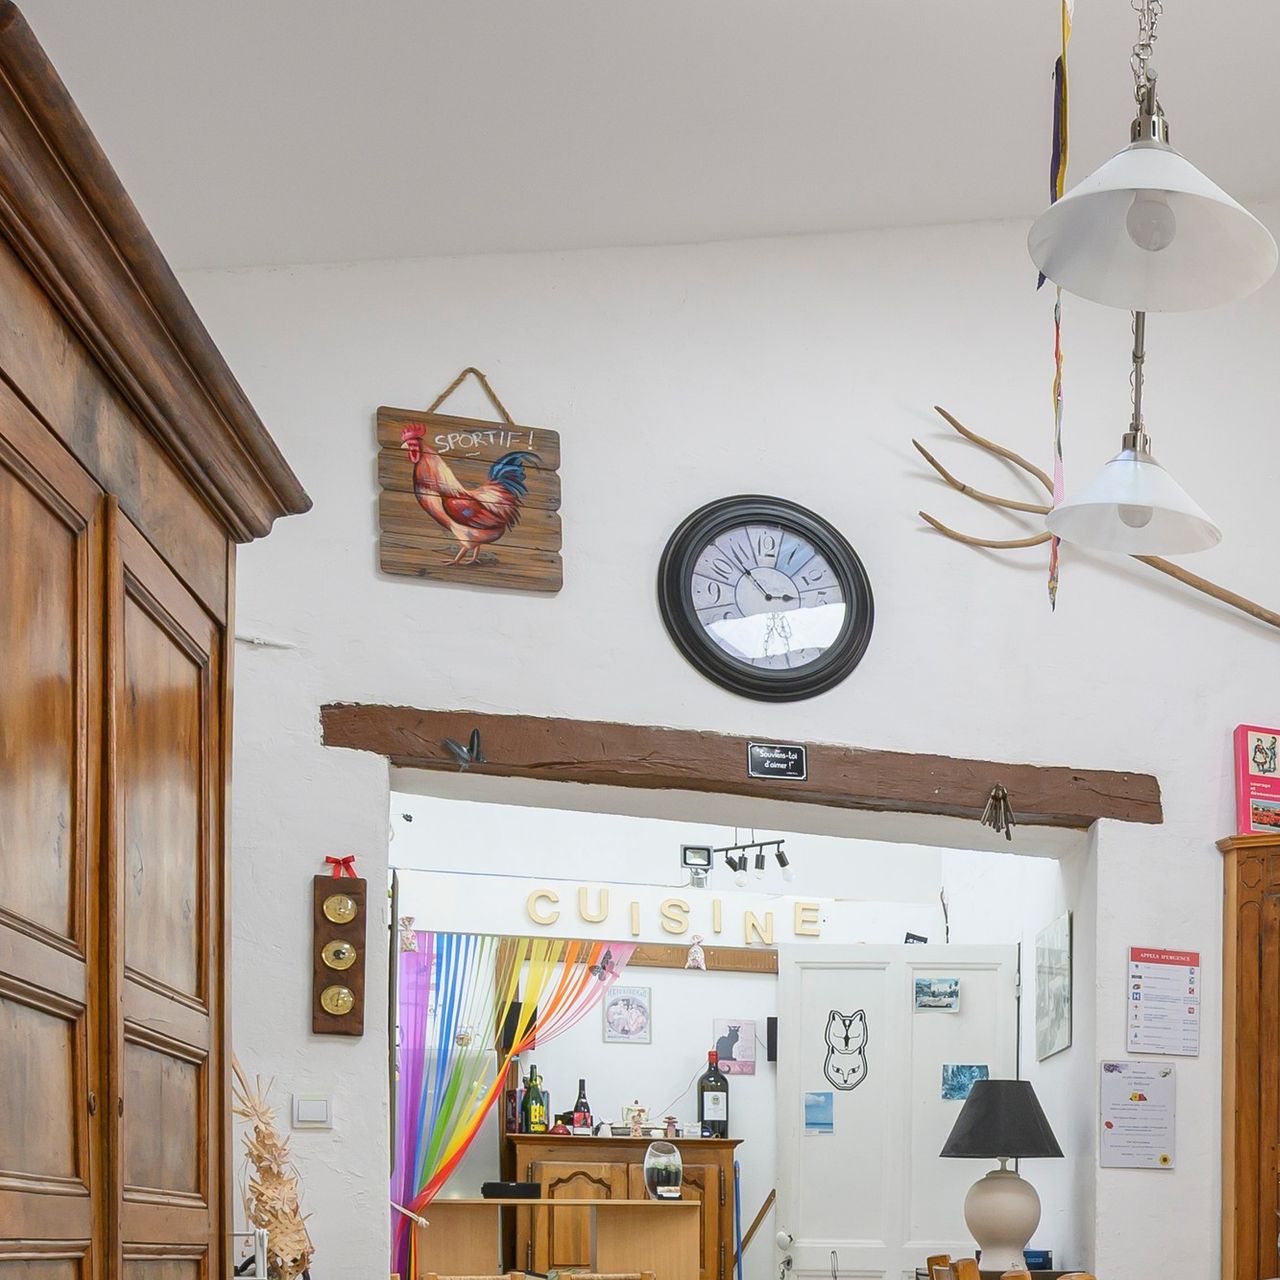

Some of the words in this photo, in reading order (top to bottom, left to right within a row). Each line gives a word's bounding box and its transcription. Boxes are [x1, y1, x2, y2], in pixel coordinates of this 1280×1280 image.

[758, 535, 776, 558] 12
[711, 557, 734, 581] 10
[707, 582, 721, 605] 9
[526, 886, 821, 945] CUISINE
